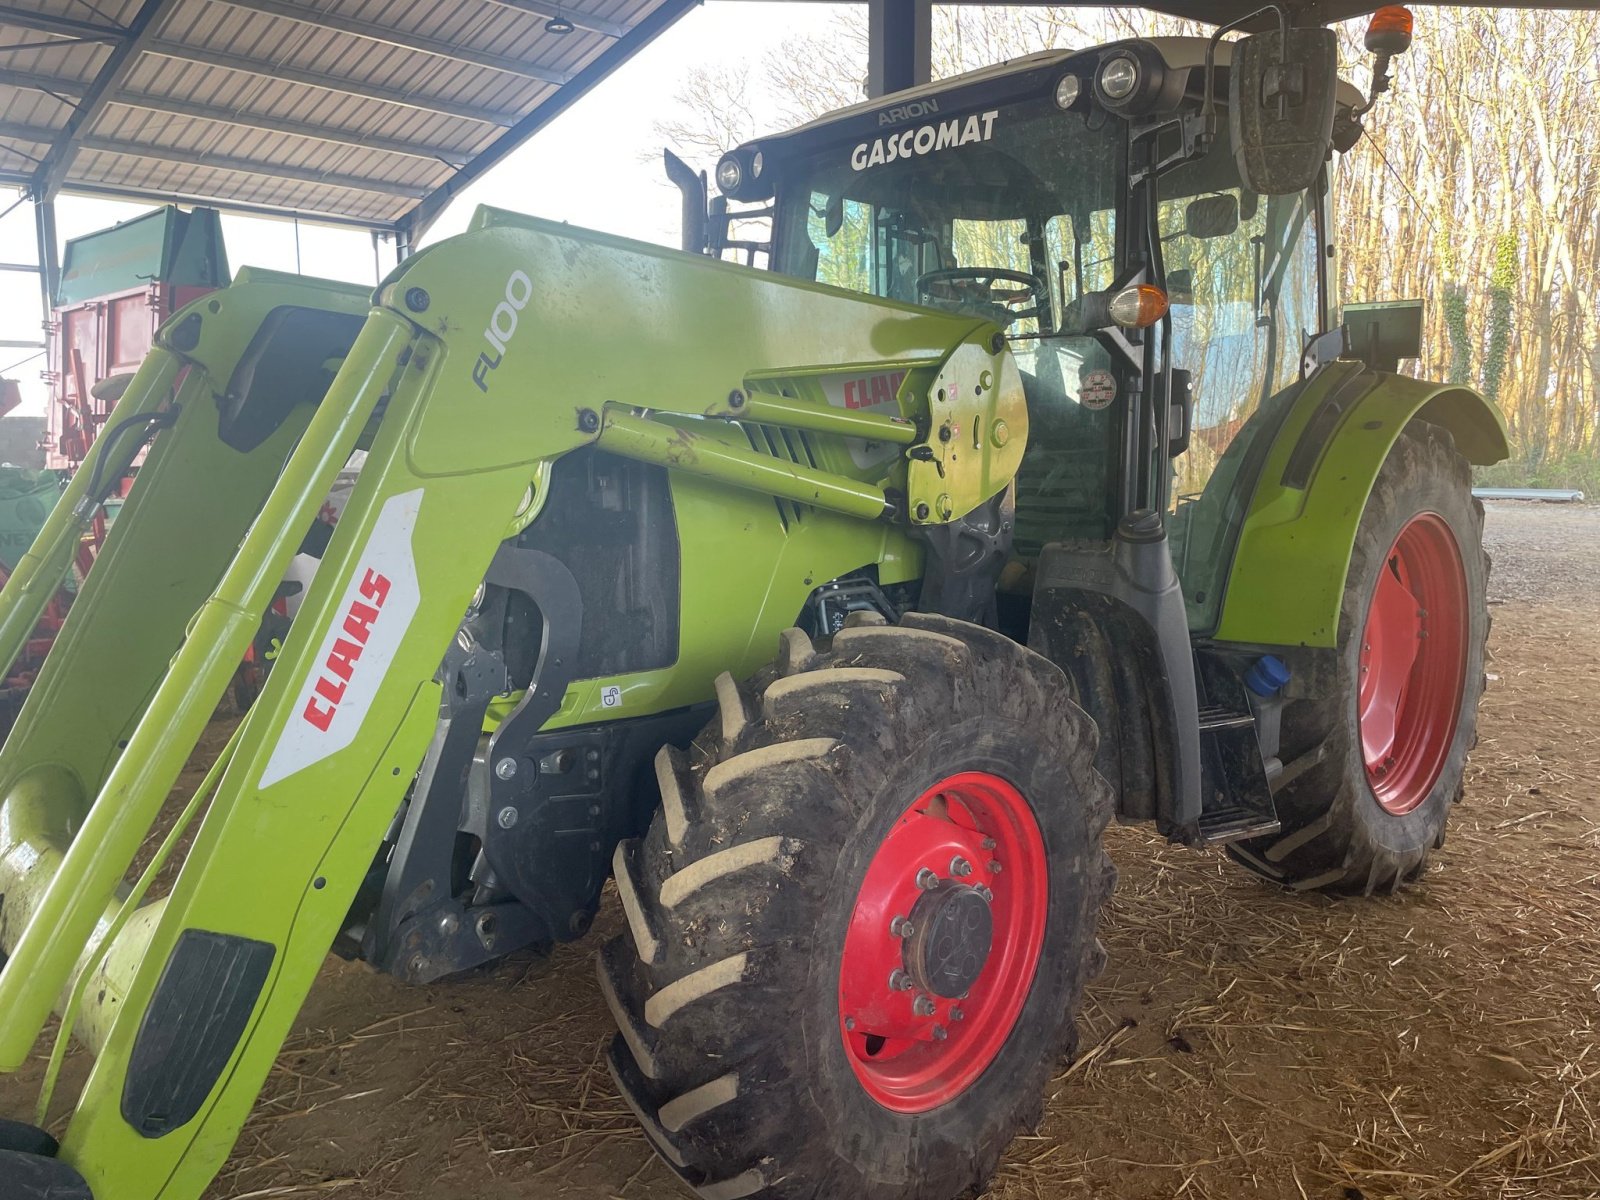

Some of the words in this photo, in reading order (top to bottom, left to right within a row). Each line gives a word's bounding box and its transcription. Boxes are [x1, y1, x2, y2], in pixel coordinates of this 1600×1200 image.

[851, 110, 999, 172] GASCOMAT
[878, 98, 940, 126] ARION
[472, 269, 532, 394] FL100
[843, 372, 906, 410] CLAA
[303, 567, 391, 733] CLAAS
